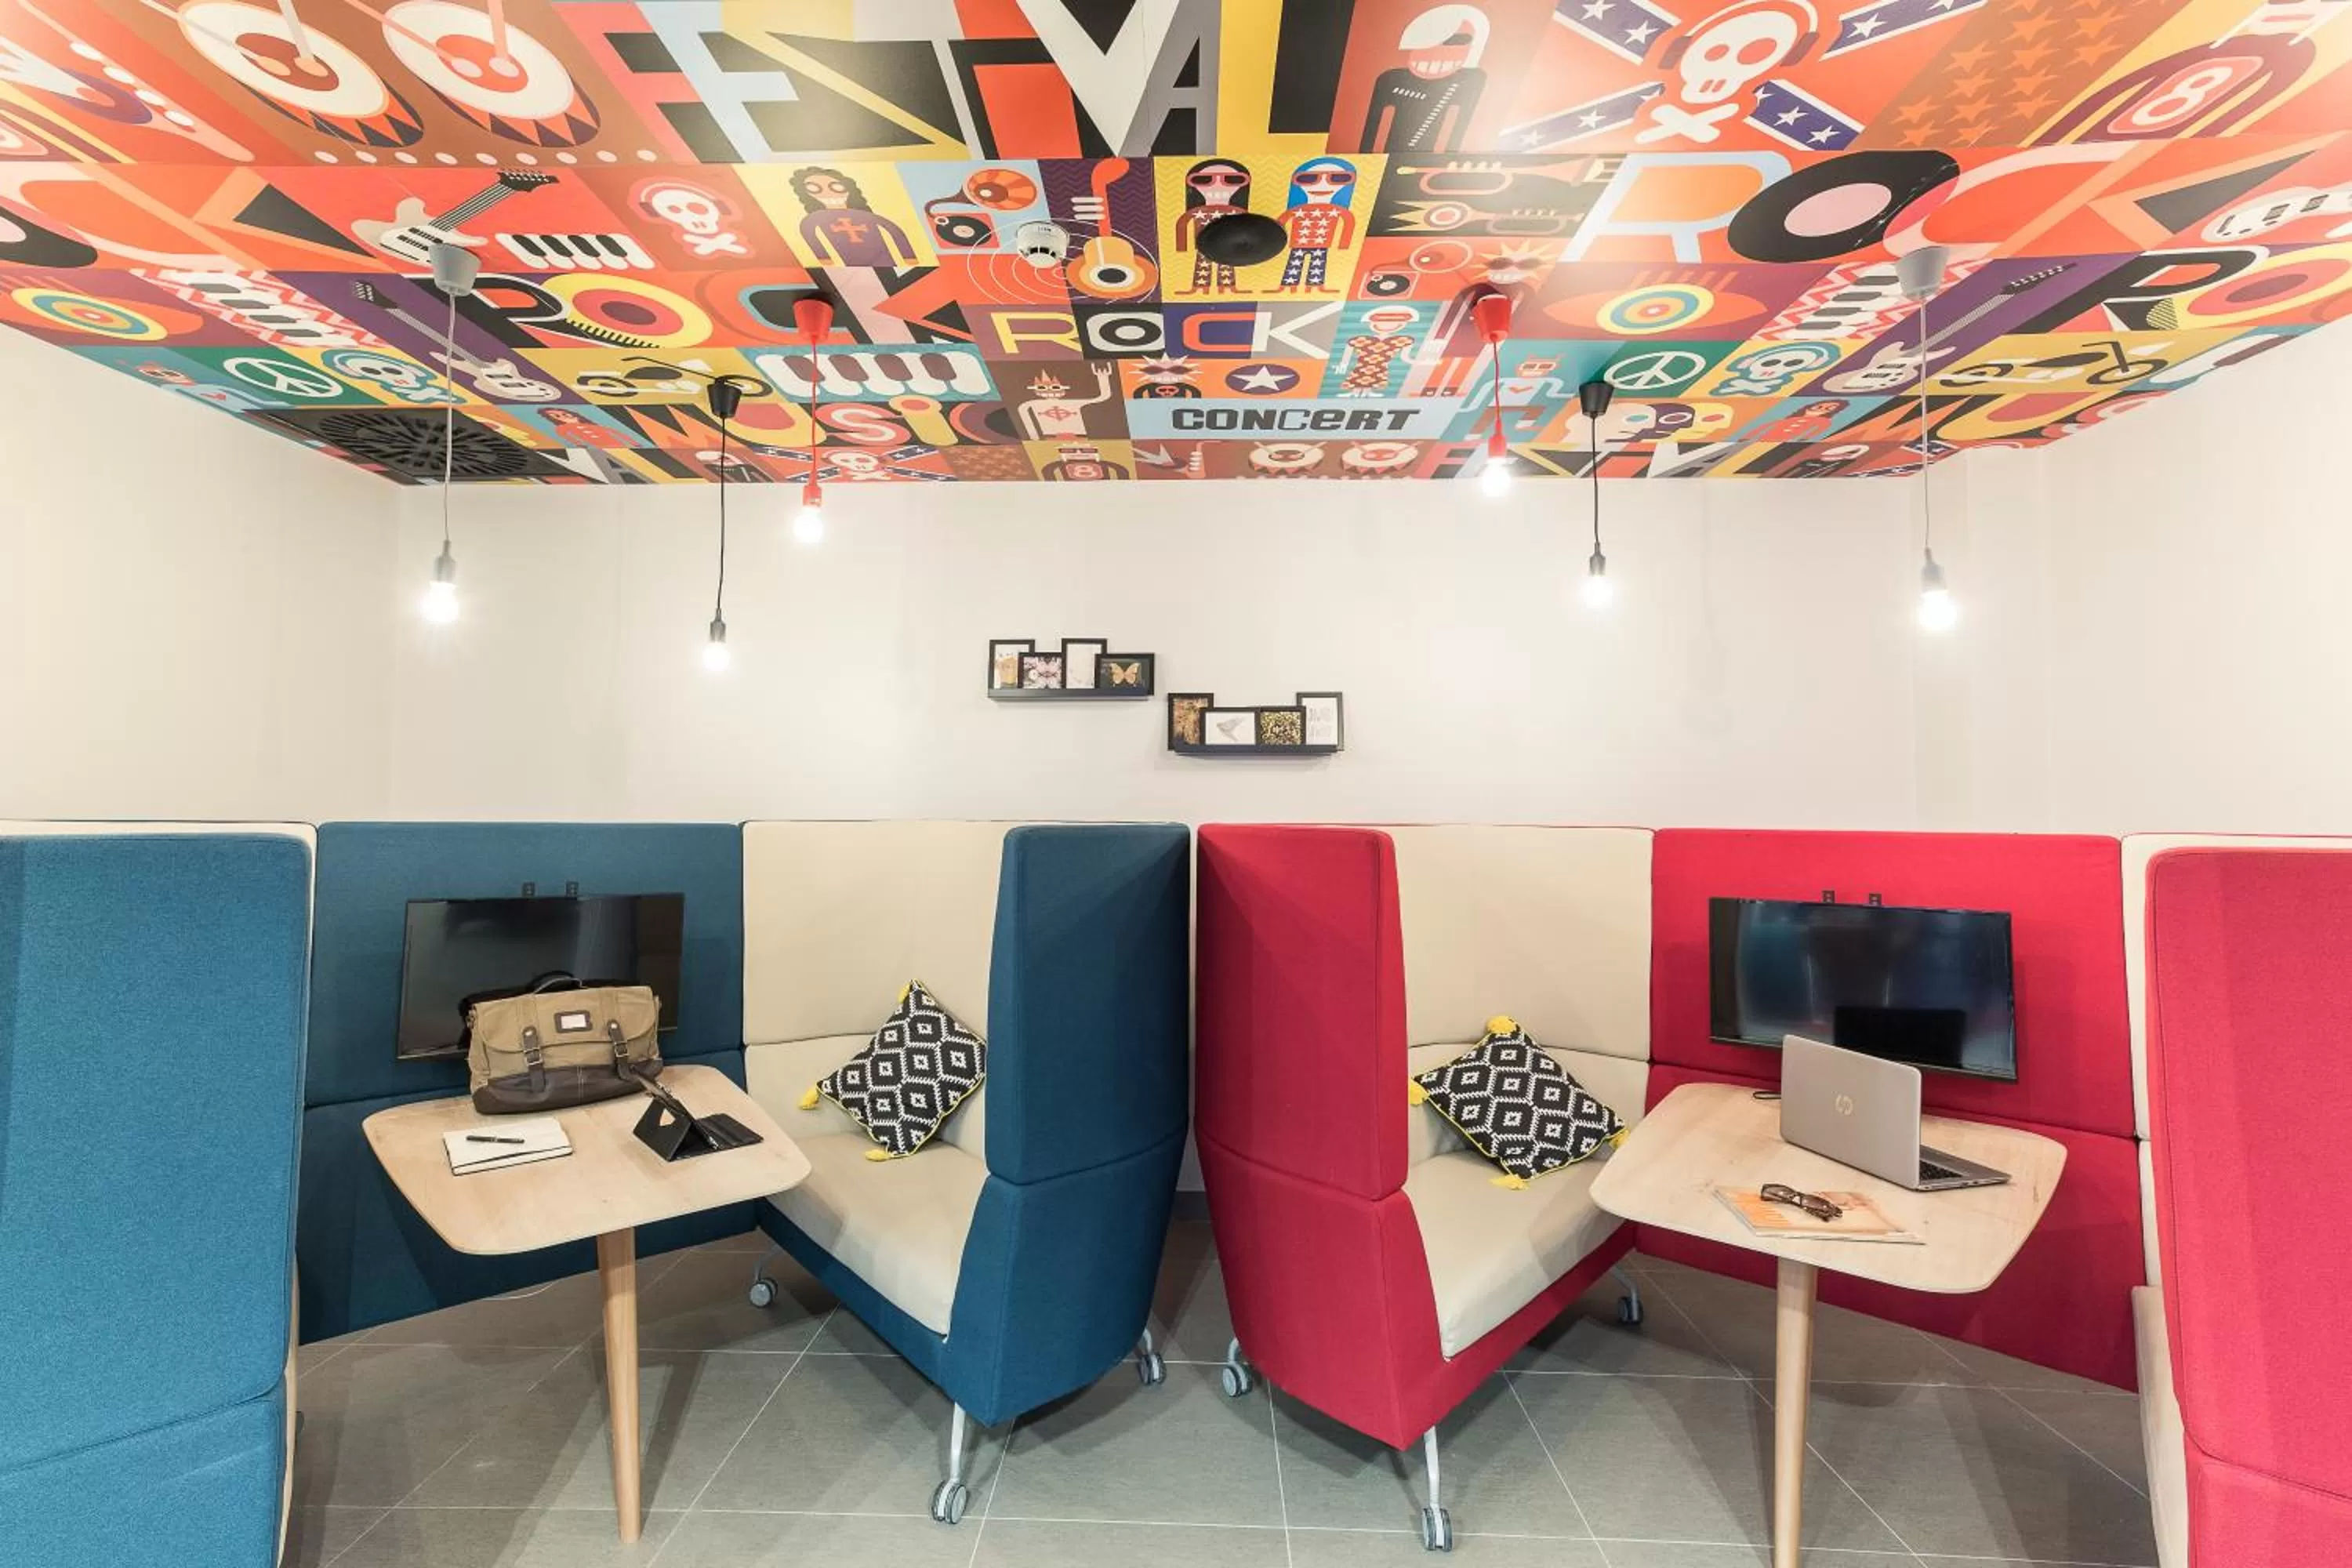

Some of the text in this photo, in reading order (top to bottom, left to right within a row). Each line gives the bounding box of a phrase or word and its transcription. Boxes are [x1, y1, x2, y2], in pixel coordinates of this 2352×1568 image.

[1558, 132, 2348, 264] ROCK
[401, 267, 976, 348] ROCK
[991, 303, 1336, 359] ROCK
